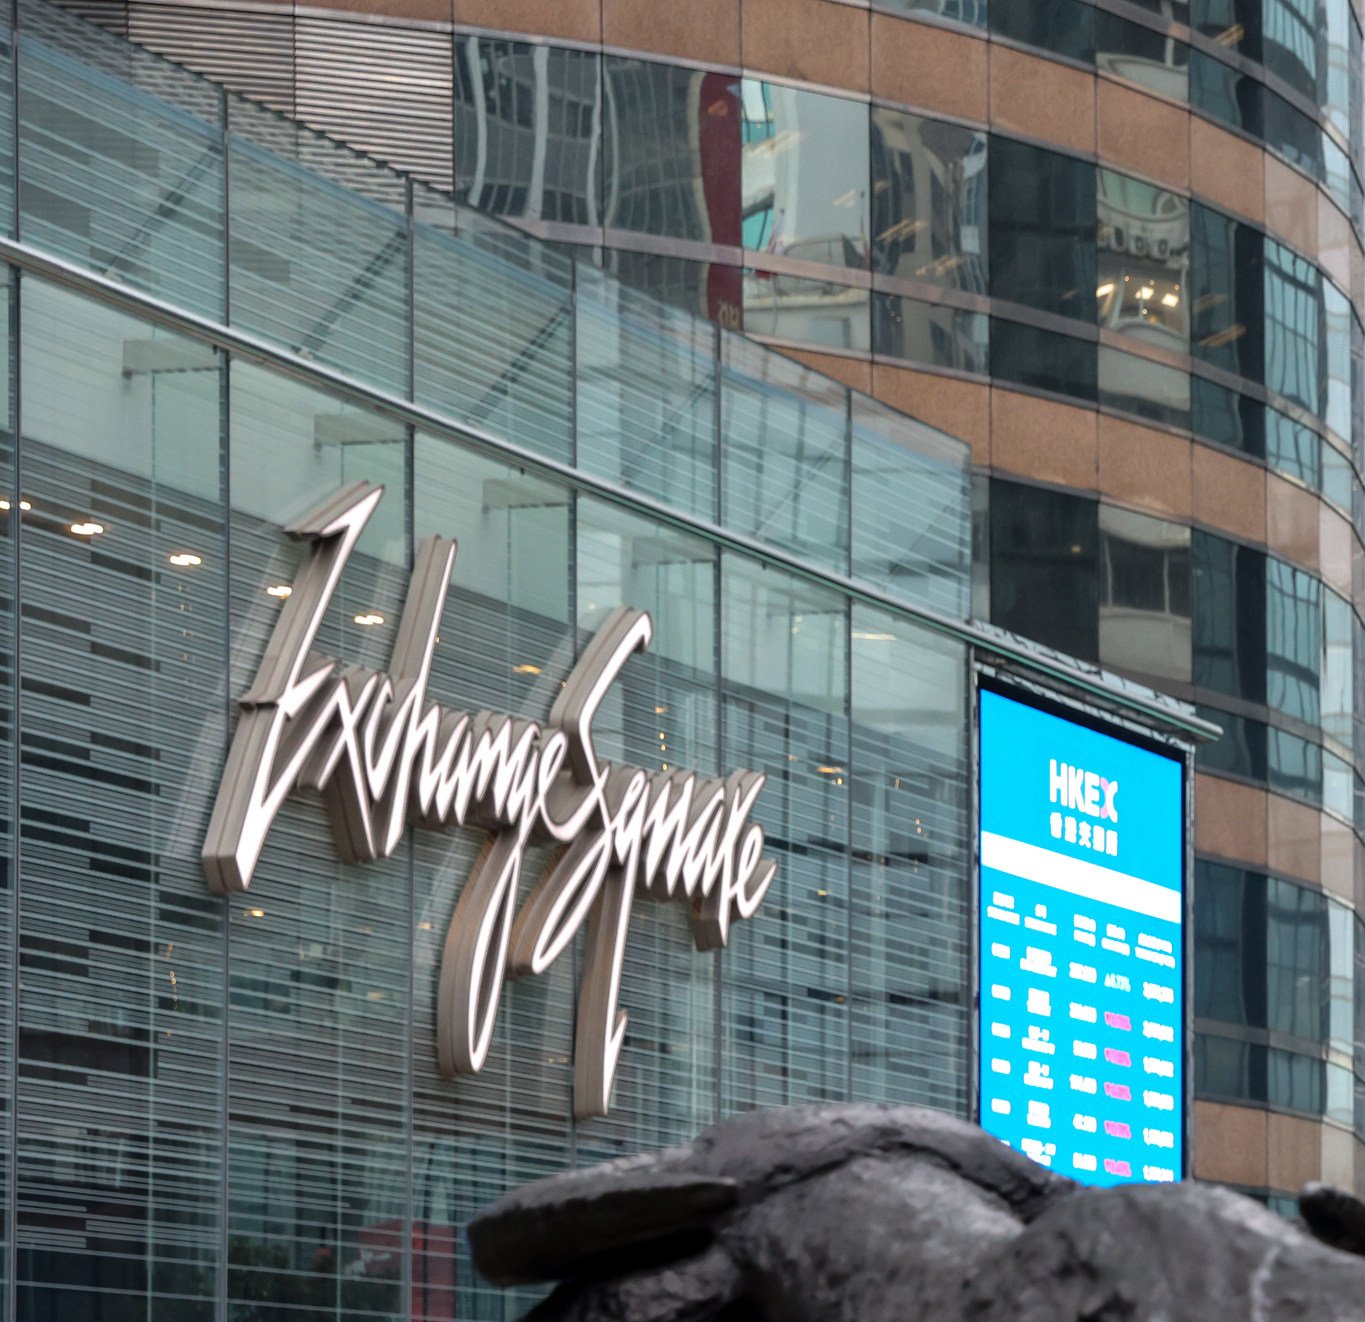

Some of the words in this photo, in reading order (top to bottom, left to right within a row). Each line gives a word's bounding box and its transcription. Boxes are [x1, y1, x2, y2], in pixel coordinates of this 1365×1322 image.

[202, 481, 572, 1075] Exchange
[508, 606, 777, 1118] Square
[1049, 758, 1119, 824] HKEX
